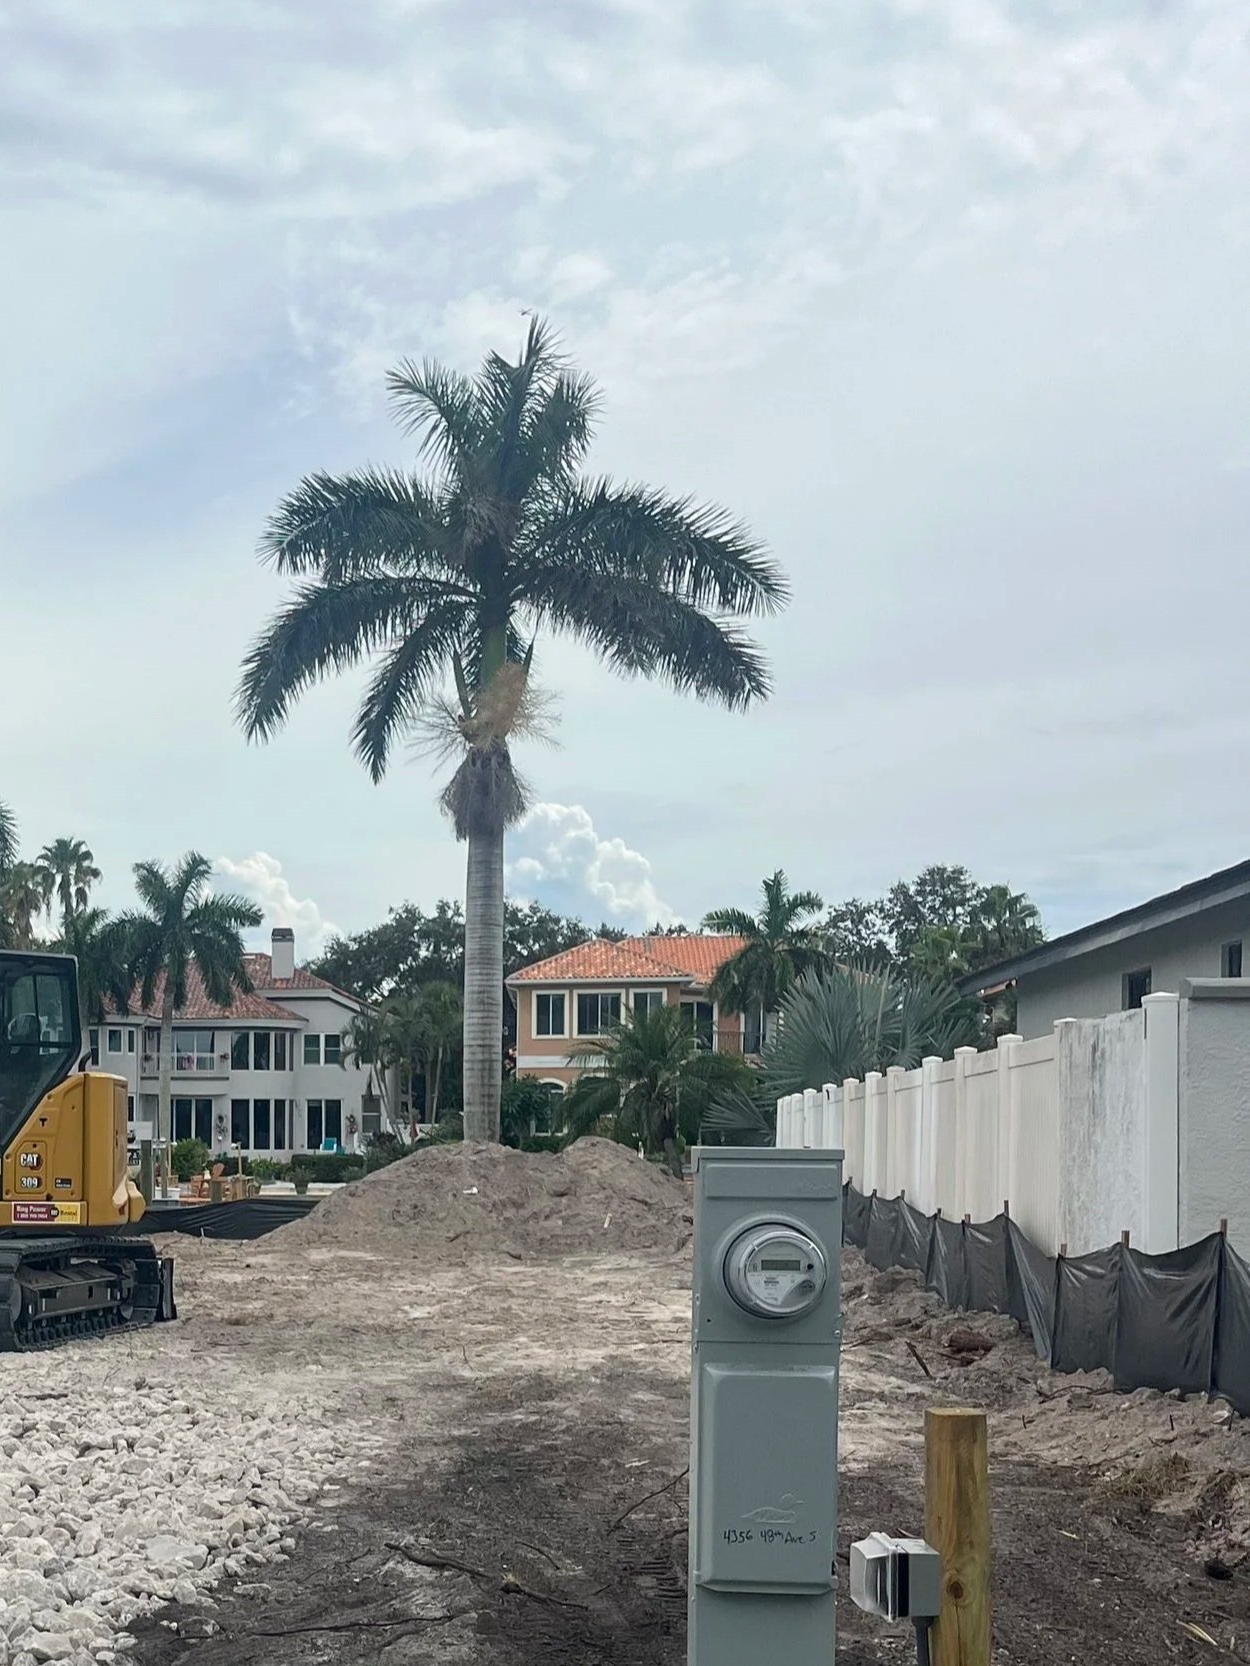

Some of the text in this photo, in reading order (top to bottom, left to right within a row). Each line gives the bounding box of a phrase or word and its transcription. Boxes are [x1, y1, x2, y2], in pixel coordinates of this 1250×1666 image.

[20, 1153, 39, 1167] CAT
[21, 1177, 38, 1188] 309
[723, 1529, 753, 1544] 4356
